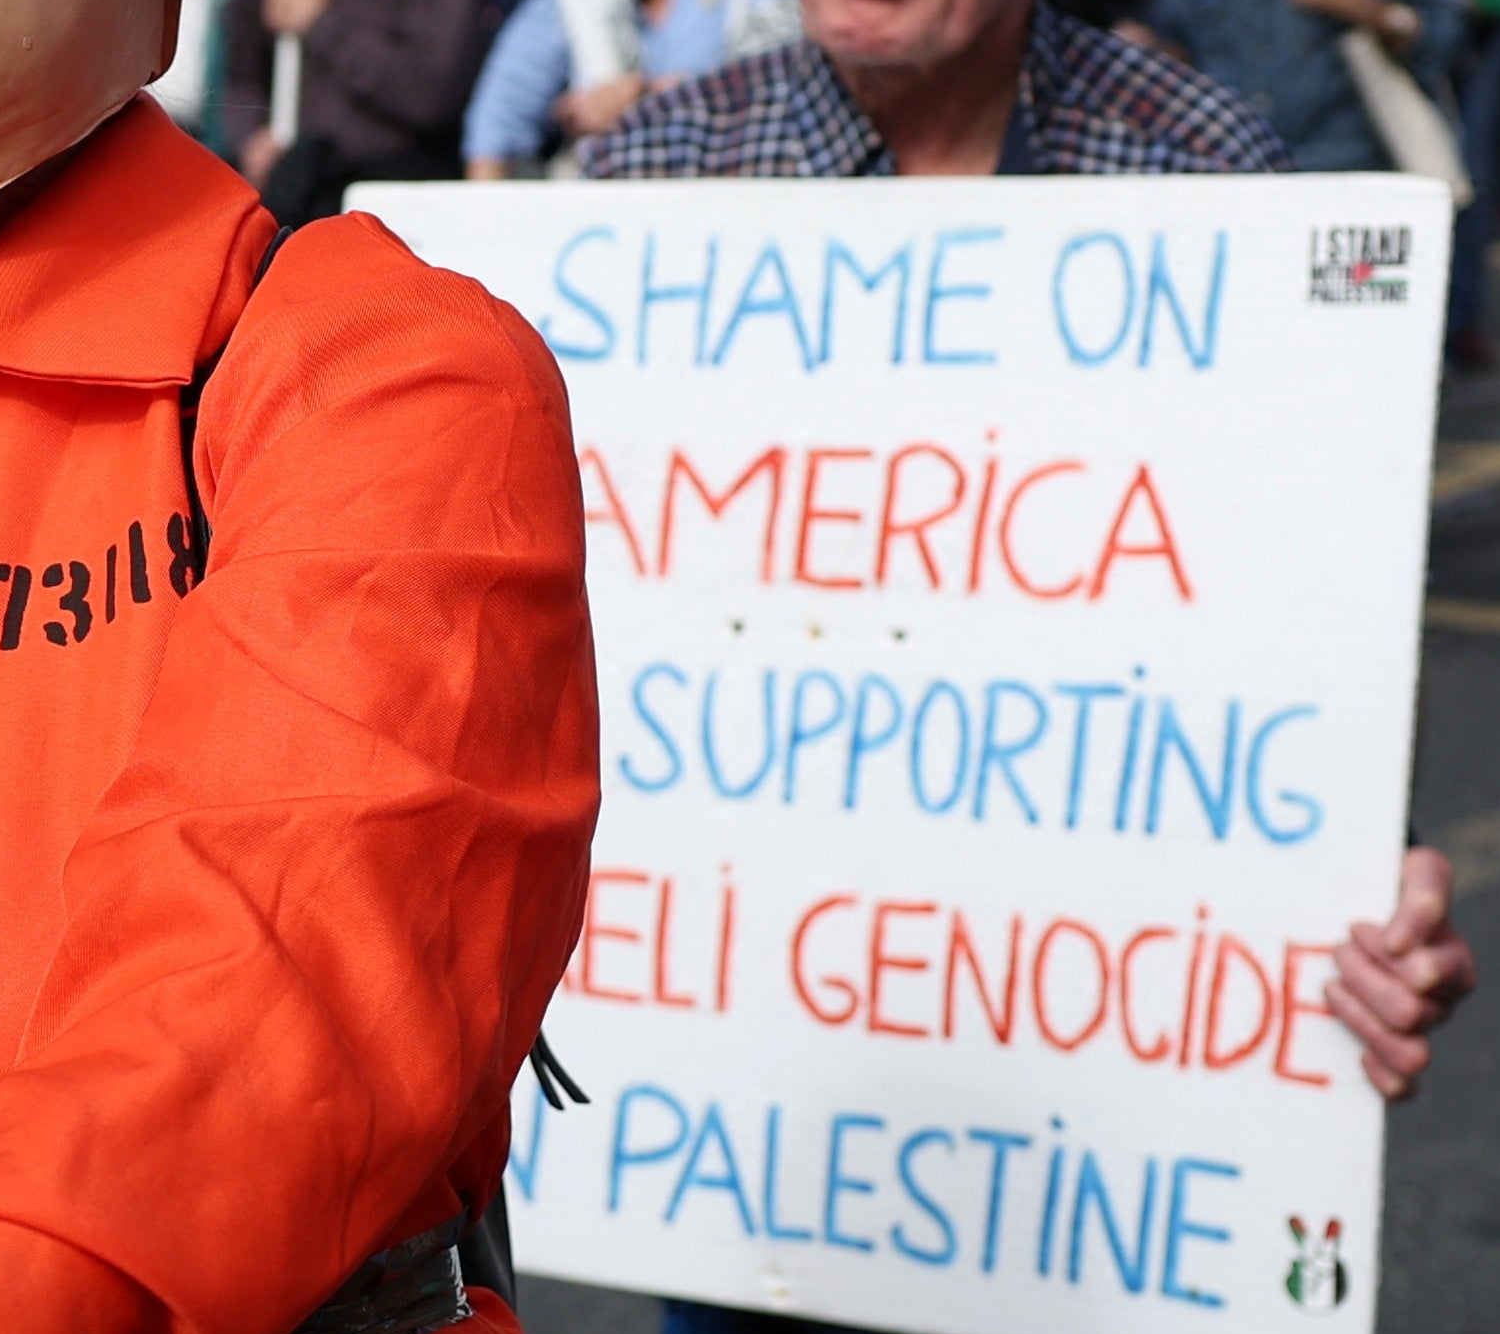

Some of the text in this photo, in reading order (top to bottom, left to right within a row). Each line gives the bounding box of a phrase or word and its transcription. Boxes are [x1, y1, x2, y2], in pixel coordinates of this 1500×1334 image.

[1328, 226, 1411, 266] STAND
[540, 224, 1229, 372] SHAME ON
